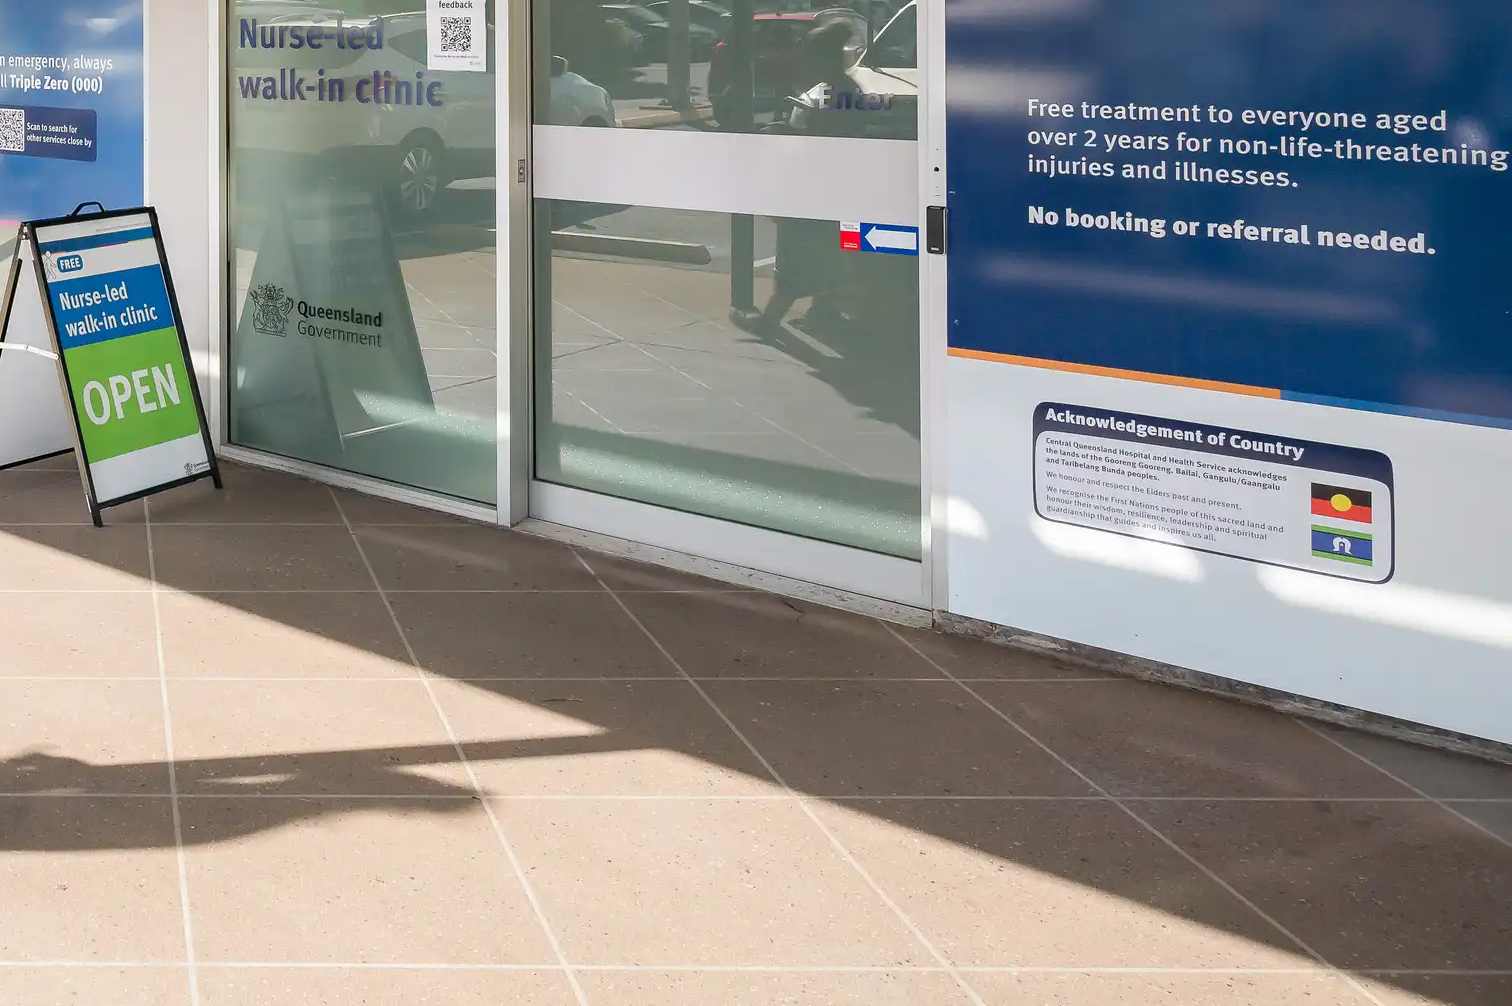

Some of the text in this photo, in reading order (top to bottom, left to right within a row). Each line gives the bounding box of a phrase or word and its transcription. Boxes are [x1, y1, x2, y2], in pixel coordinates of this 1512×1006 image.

[438, 0, 473, 8] feedback
[239, 14, 384, 50] Nurse-led
[8, 55, 70, 72] emergency,
[74, 54, 113, 73] always
[10, 74, 41, 92] Triple
[44, 76, 68, 90] Zero
[72, 76, 103, 94] (000)
[238, 68, 444, 107] walk-in clinic
[819, 85, 895, 110] Enter
[26, 122, 78, 134] Scan to search for
[1028, 98, 1447, 135] Free treatment to everyone aged
[26, 134, 92, 148] other services close by
[1028, 130, 1510, 172] over 2 years for non-life-threatening
[1028, 154, 1298, 188] injuries and illnesses.
[1028, 206, 1436, 255] No booking or referral needed.
[60, 258, 81, 270] FREE
[59, 281, 128, 311] Nurse-led
[65, 304, 158, 338] walk-in clinic
[297, 300, 384, 328] Queensland
[297, 320, 382, 348] Government
[82, 362, 181, 426] OPEN
[1045, 408, 1304, 461] Acknowledgement of Country
[1046, 438, 1288, 482] Central Queensland Hospital and Health Service acknowledges
[1060, 449, 1079, 458] lands
[1090, 454, 1102, 462] the
[1104, 457, 1136, 468] Gooreng
[1203, 472, 1281, 491] Gangulu/Gaangalu
[1061, 458, 1100, 472] Taribelang
[1102, 465, 1125, 475] Bunda
[1128, 470, 1160, 481] peoples.
[1059, 472, 1085, 483] honour
[1086, 478, 1100, 486] and
[1102, 481, 1130, 491] respect
[1132, 485, 1144, 493] the
[1146, 487, 1170, 498] Elders
[1172, 494, 1189, 502] past
[1191, 496, 1206, 504] and
[1046, 494, 1072, 505] honour
[1074, 499, 1092, 508] their
[1094, 505, 1125, 515] wisdom,
[1170, 517, 1212, 531] leadership
[1215, 525, 1230, 534] and
[1232, 528, 1267, 540] spiritual
[1046, 506, 1096, 520] guardianship
[1097, 514, 1112, 522] that
[1114, 516, 1140, 527] guides
[1159, 525, 1190, 536] inspires
[1204, 533, 1216, 541] all.
[1059, 488, 1095, 499] recognise
[1110, 497, 1128, 506] First
[1129, 500, 1159, 511] Nations
[1162, 506, 1188, 516] people
[1200, 512, 1215, 521] this
[1218, 516, 1245, 527] sacred
[1247, 520, 1266, 530] land
[1268, 524, 1284, 533] and
